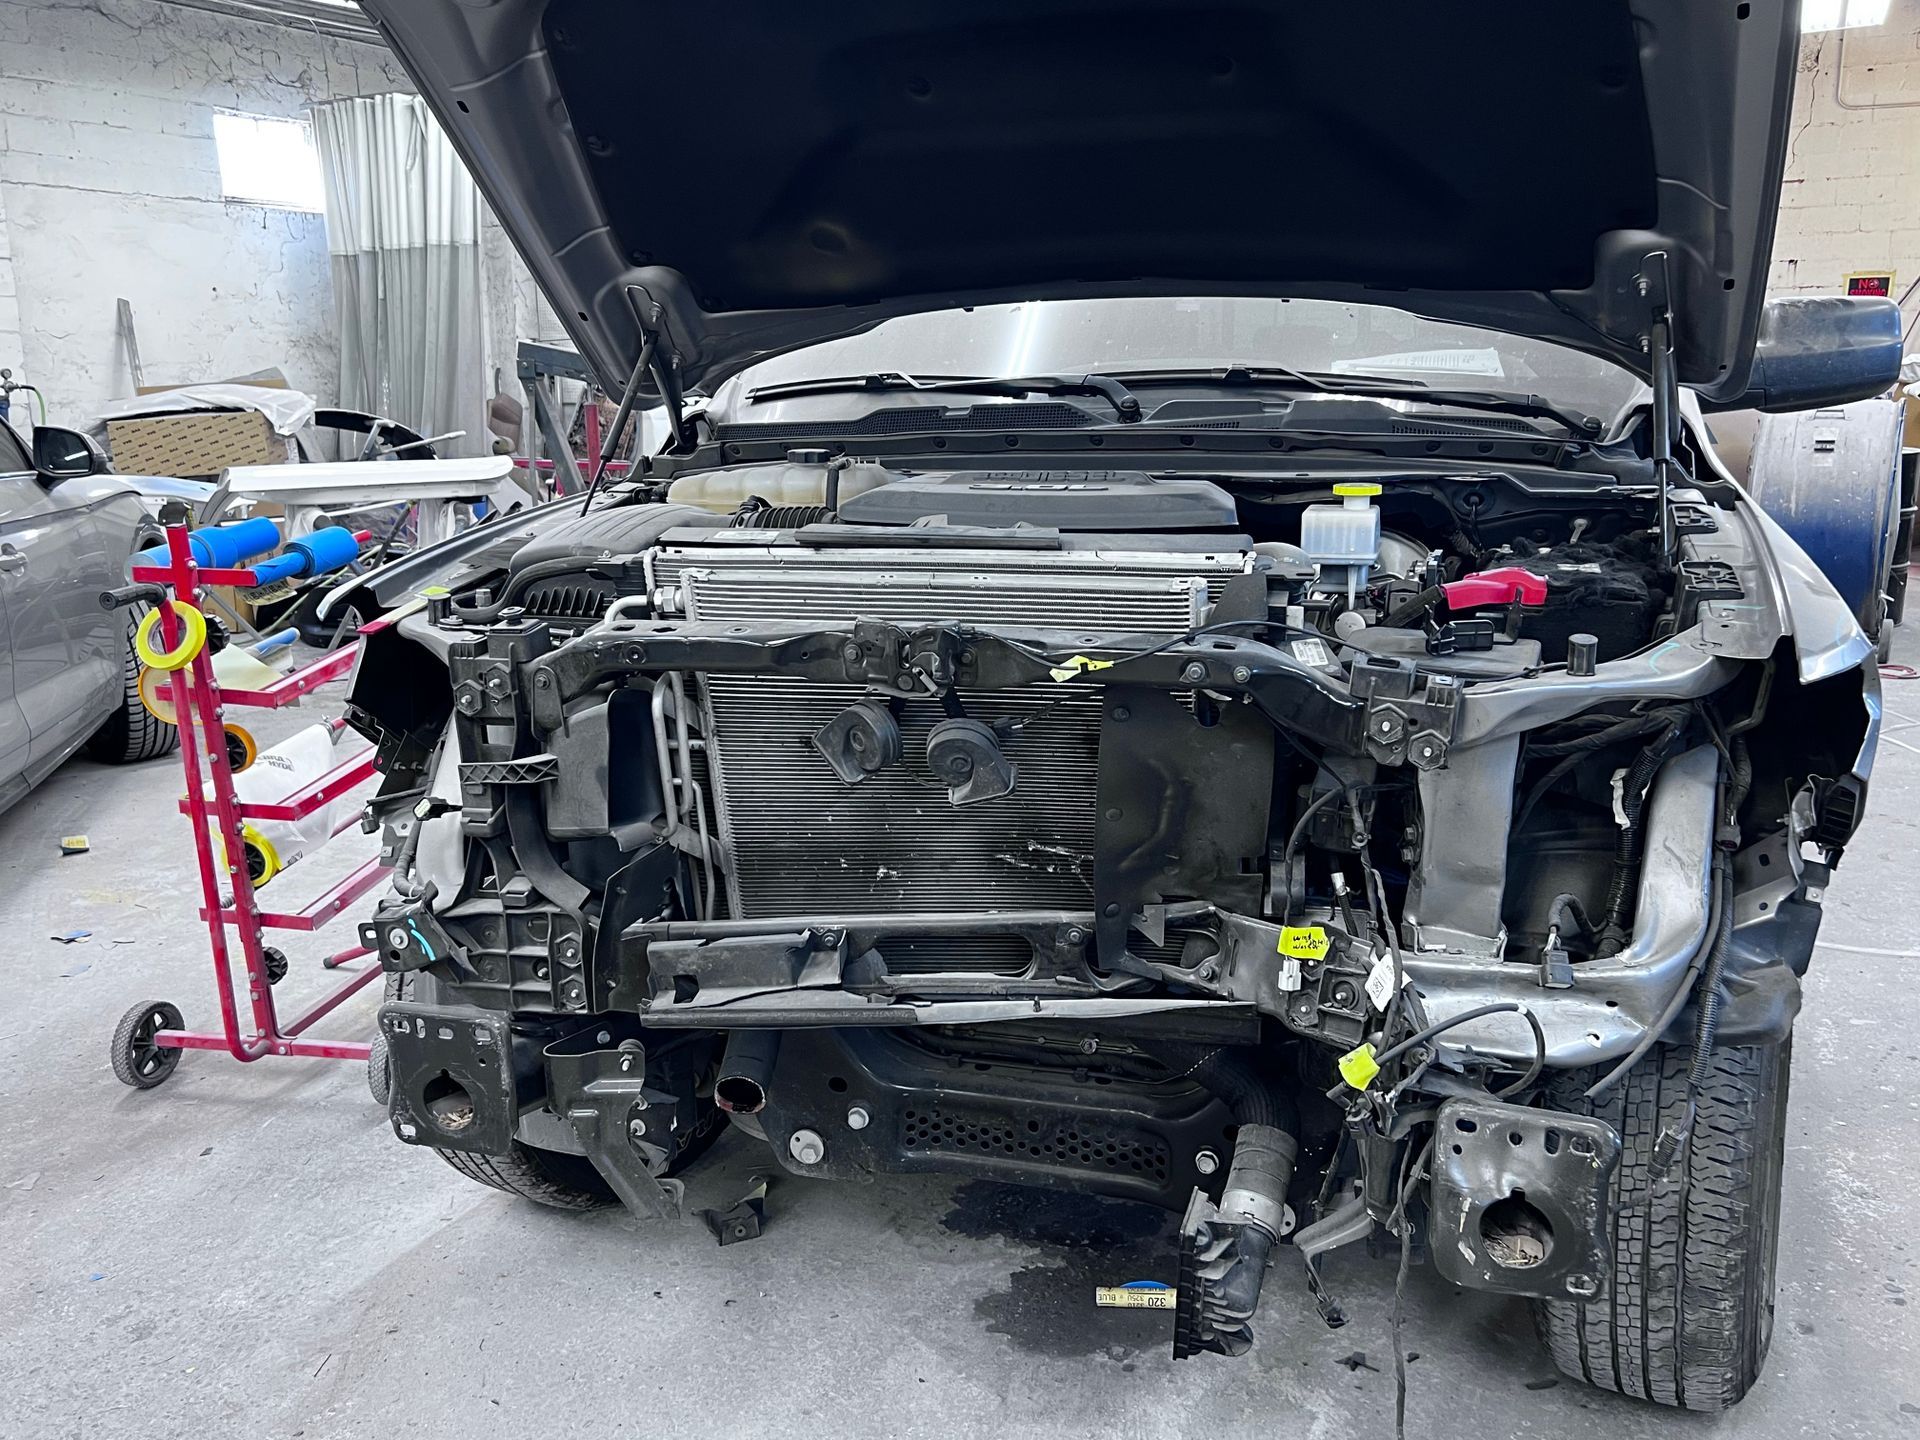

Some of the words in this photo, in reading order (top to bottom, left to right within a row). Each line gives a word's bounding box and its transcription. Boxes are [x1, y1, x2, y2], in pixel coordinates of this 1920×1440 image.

[1858, 279, 1880, 289] NO
[1850, 288, 1887, 297] SMOKING
[1098, 1294, 1116, 1302] BLUE
[1148, 1297, 1166, 1308] 320
